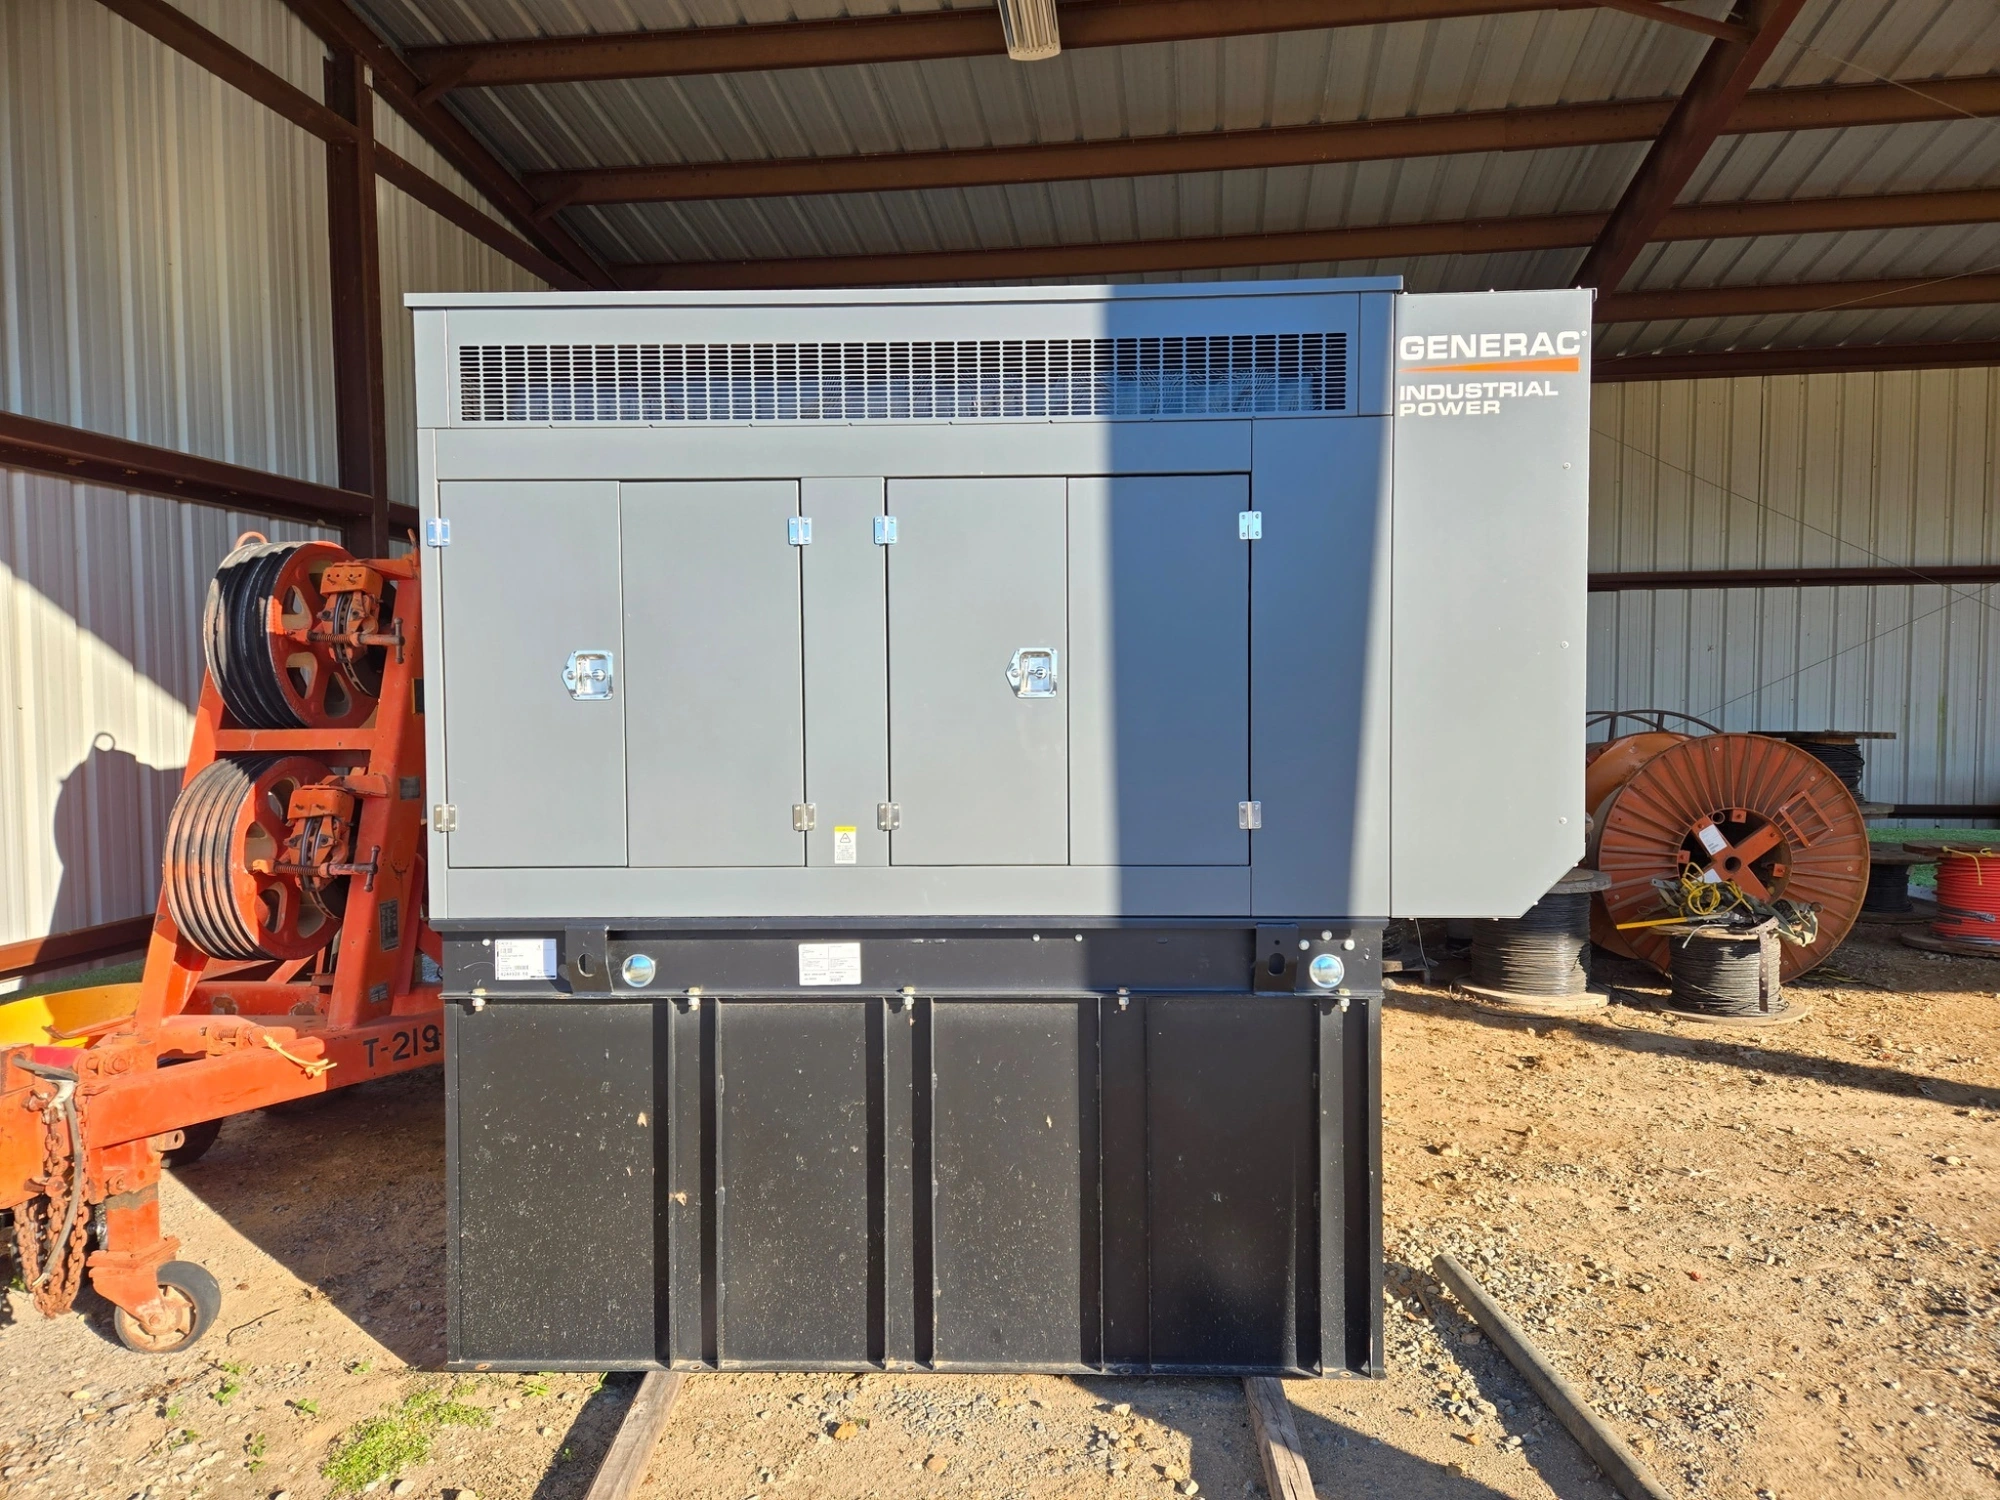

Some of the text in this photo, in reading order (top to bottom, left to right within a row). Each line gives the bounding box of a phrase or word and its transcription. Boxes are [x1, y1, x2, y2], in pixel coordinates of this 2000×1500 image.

[1399, 330, 1581, 361] GENERAC
[1399, 380, 1559, 401] INDUSTRIAL
[1399, 400, 1501, 417] POWER
[362, 1023, 441, 1068] T-219
